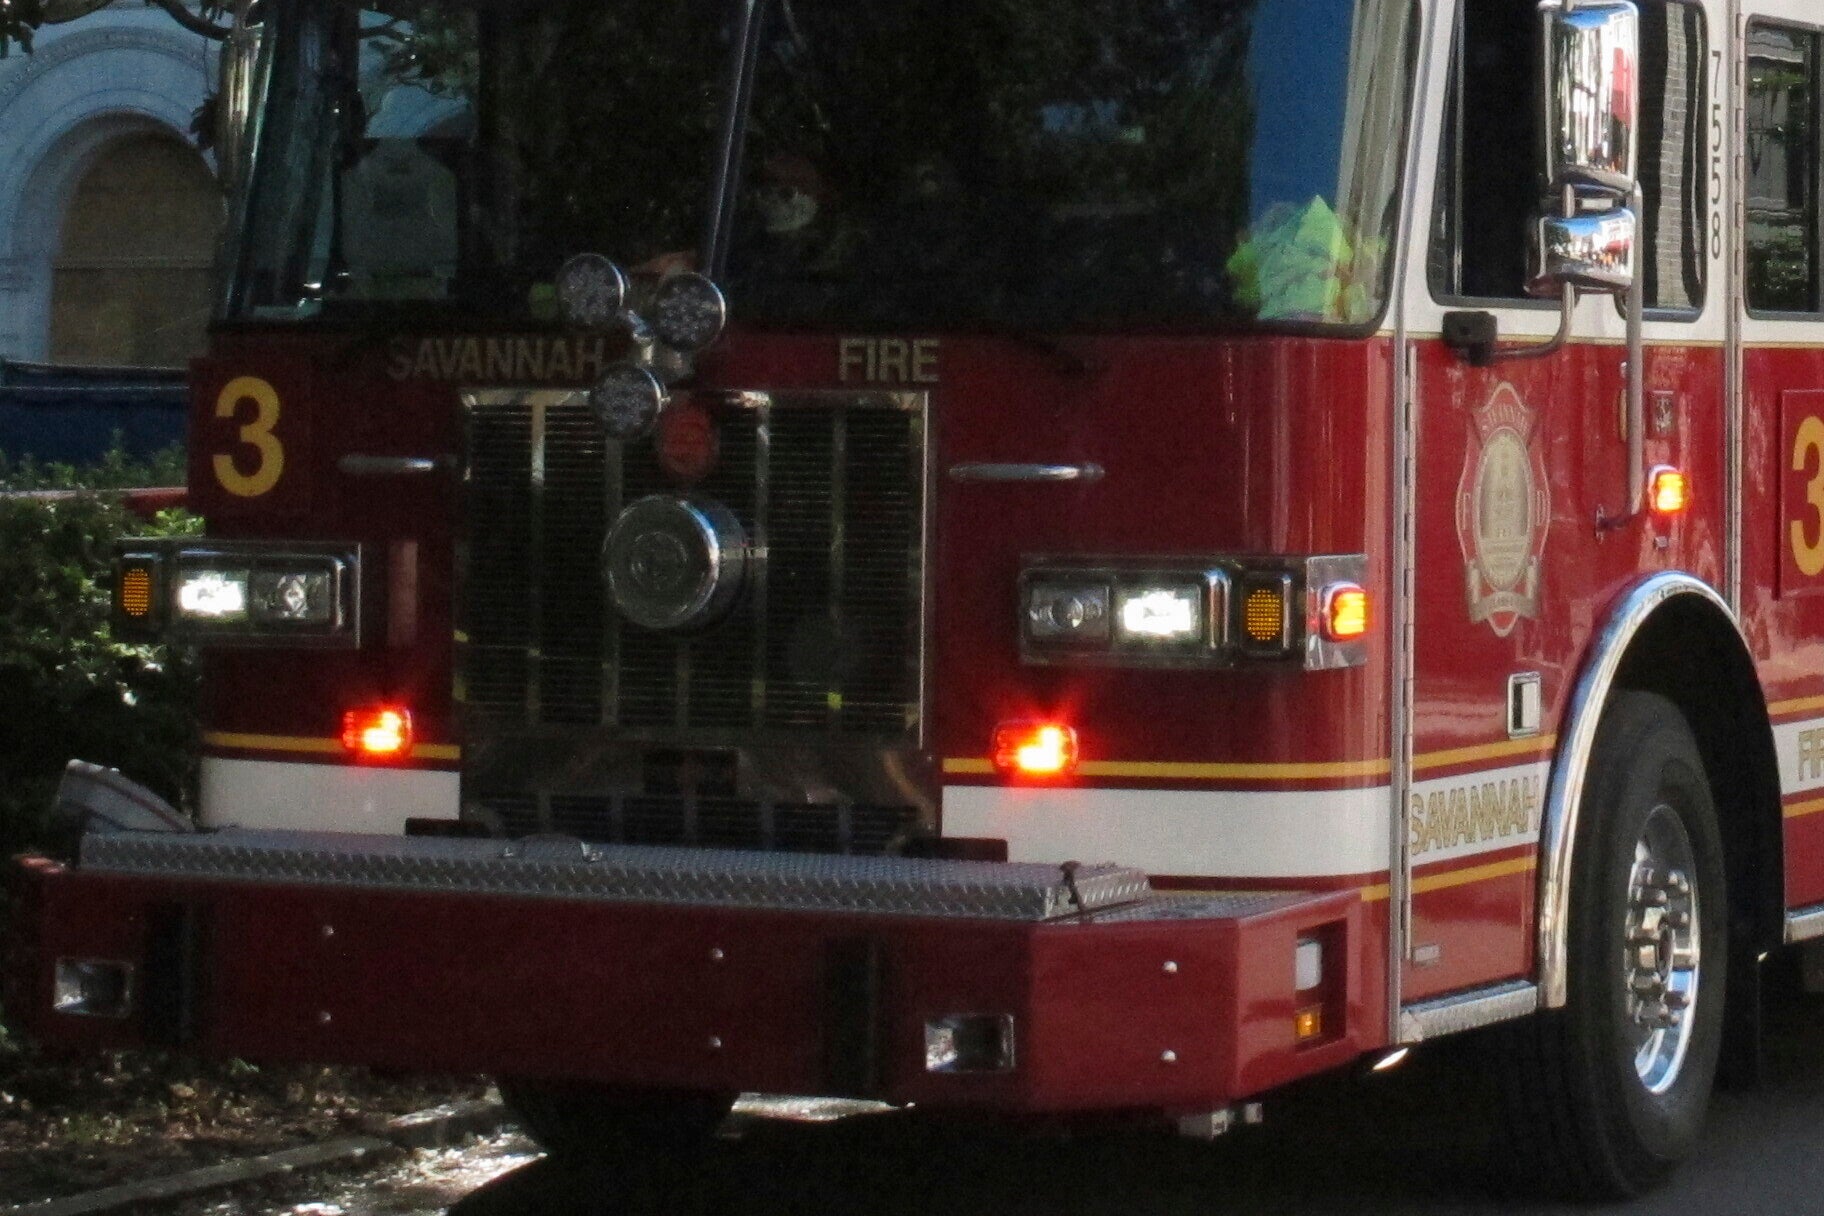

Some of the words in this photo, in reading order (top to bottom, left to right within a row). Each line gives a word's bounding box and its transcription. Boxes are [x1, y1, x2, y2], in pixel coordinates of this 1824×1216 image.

[1711, 50, 1722, 260] 7558
[386, 337, 605, 381] SAVANNAH
[840, 337, 940, 382] FIRE
[212, 375, 284, 497] 3
[1411, 774, 1539, 856] SAVANNAH
